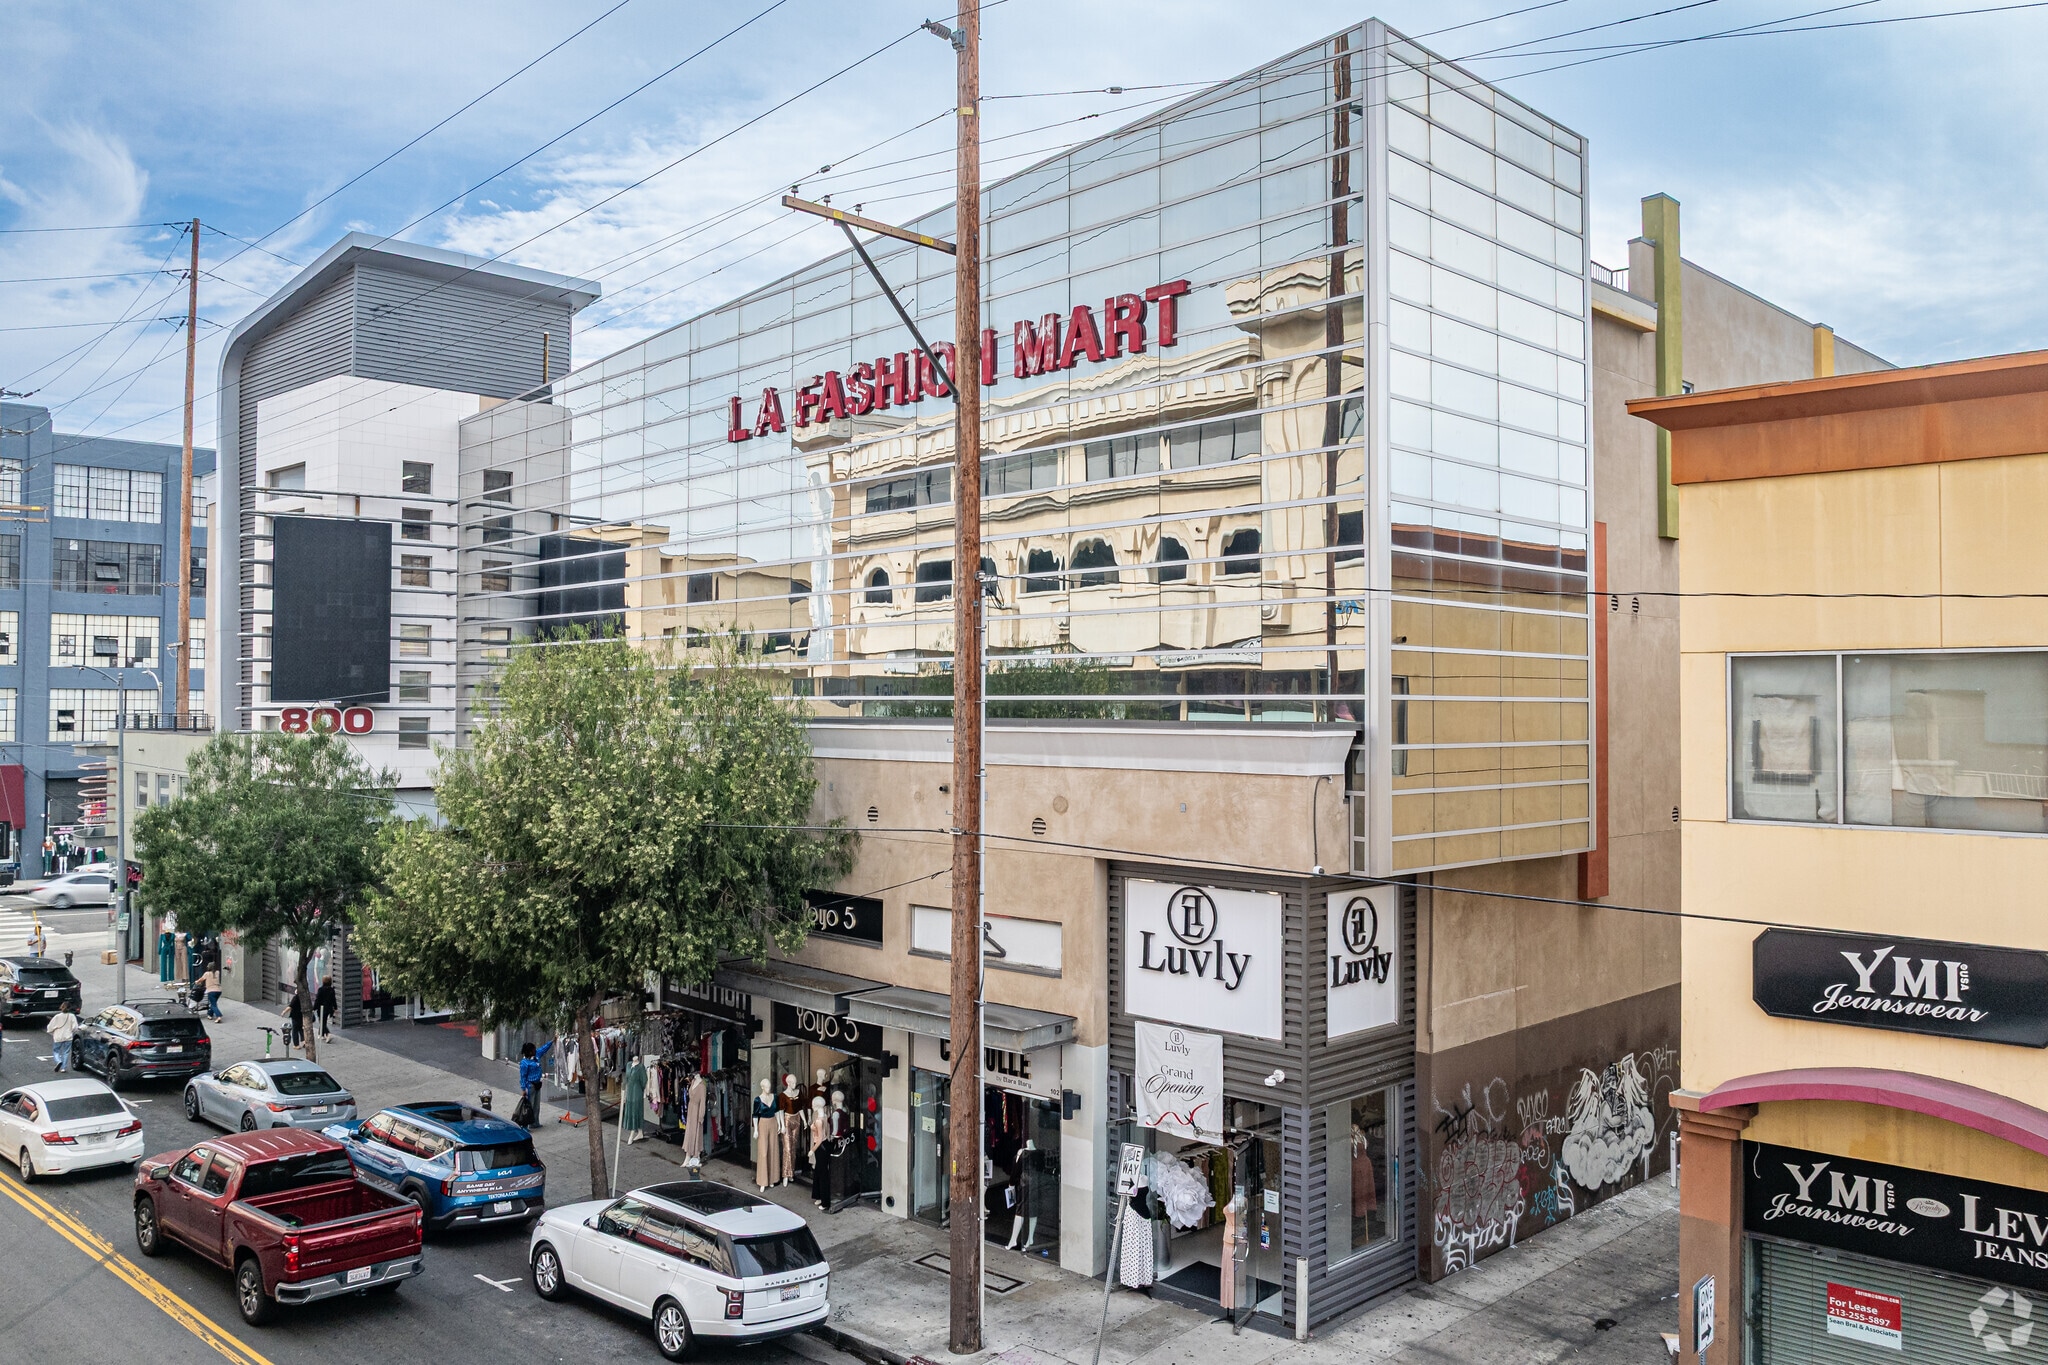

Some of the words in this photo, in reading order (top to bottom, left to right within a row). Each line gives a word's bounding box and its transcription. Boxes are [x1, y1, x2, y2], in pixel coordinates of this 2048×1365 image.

[727, 386, 788, 442] LA
[1013, 279, 1191, 379] MART
[280, 706, 375, 735] 800
[843, 906, 857, 930] 5
[1139, 930, 1252, 991] Luvly
[1330, 945, 1393, 988] Luvly
[1840, 945, 1963, 1003] YMI
[1960, 970, 1970, 991] USA
[1812, 983, 1989, 1022] Jeanswear
[796, 1006, 841, 1041] Yoyo
[1164, 1041, 1191, 1056] Luvly
[1160, 1064, 1194, 1080] Grand
[1050, 1088, 1060, 1096] 102
[1145, 1074, 1205, 1101] Opening.
[1123, 1162, 1139, 1175] WAY
[1783, 1161, 1889, 1217] YMI
[1886, 1190, 1896, 1210] USA
[1763, 1193, 1915, 1237] Jeanswear
[1959, 1193, 2048, 1246] LEV
[1974, 1239, 2048, 1269] JEANS
[765, 1278, 790, 1286] RANGE
[794, 1273, 817, 1281] ROVER
[1701, 1283, 1713, 1307] ONE
[1829, 1296, 1847, 1308] For
[1848, 1300, 1879, 1315] Lease
[1701, 1302, 1713, 1325] WAY
[1829, 1307, 1891, 1327] 213-255-5897
[1829, 1317, 1845, 1326] Sean
[1845, 1320, 1858, 1329] Bral
[1864, 1325, 1899, 1339] Associates
